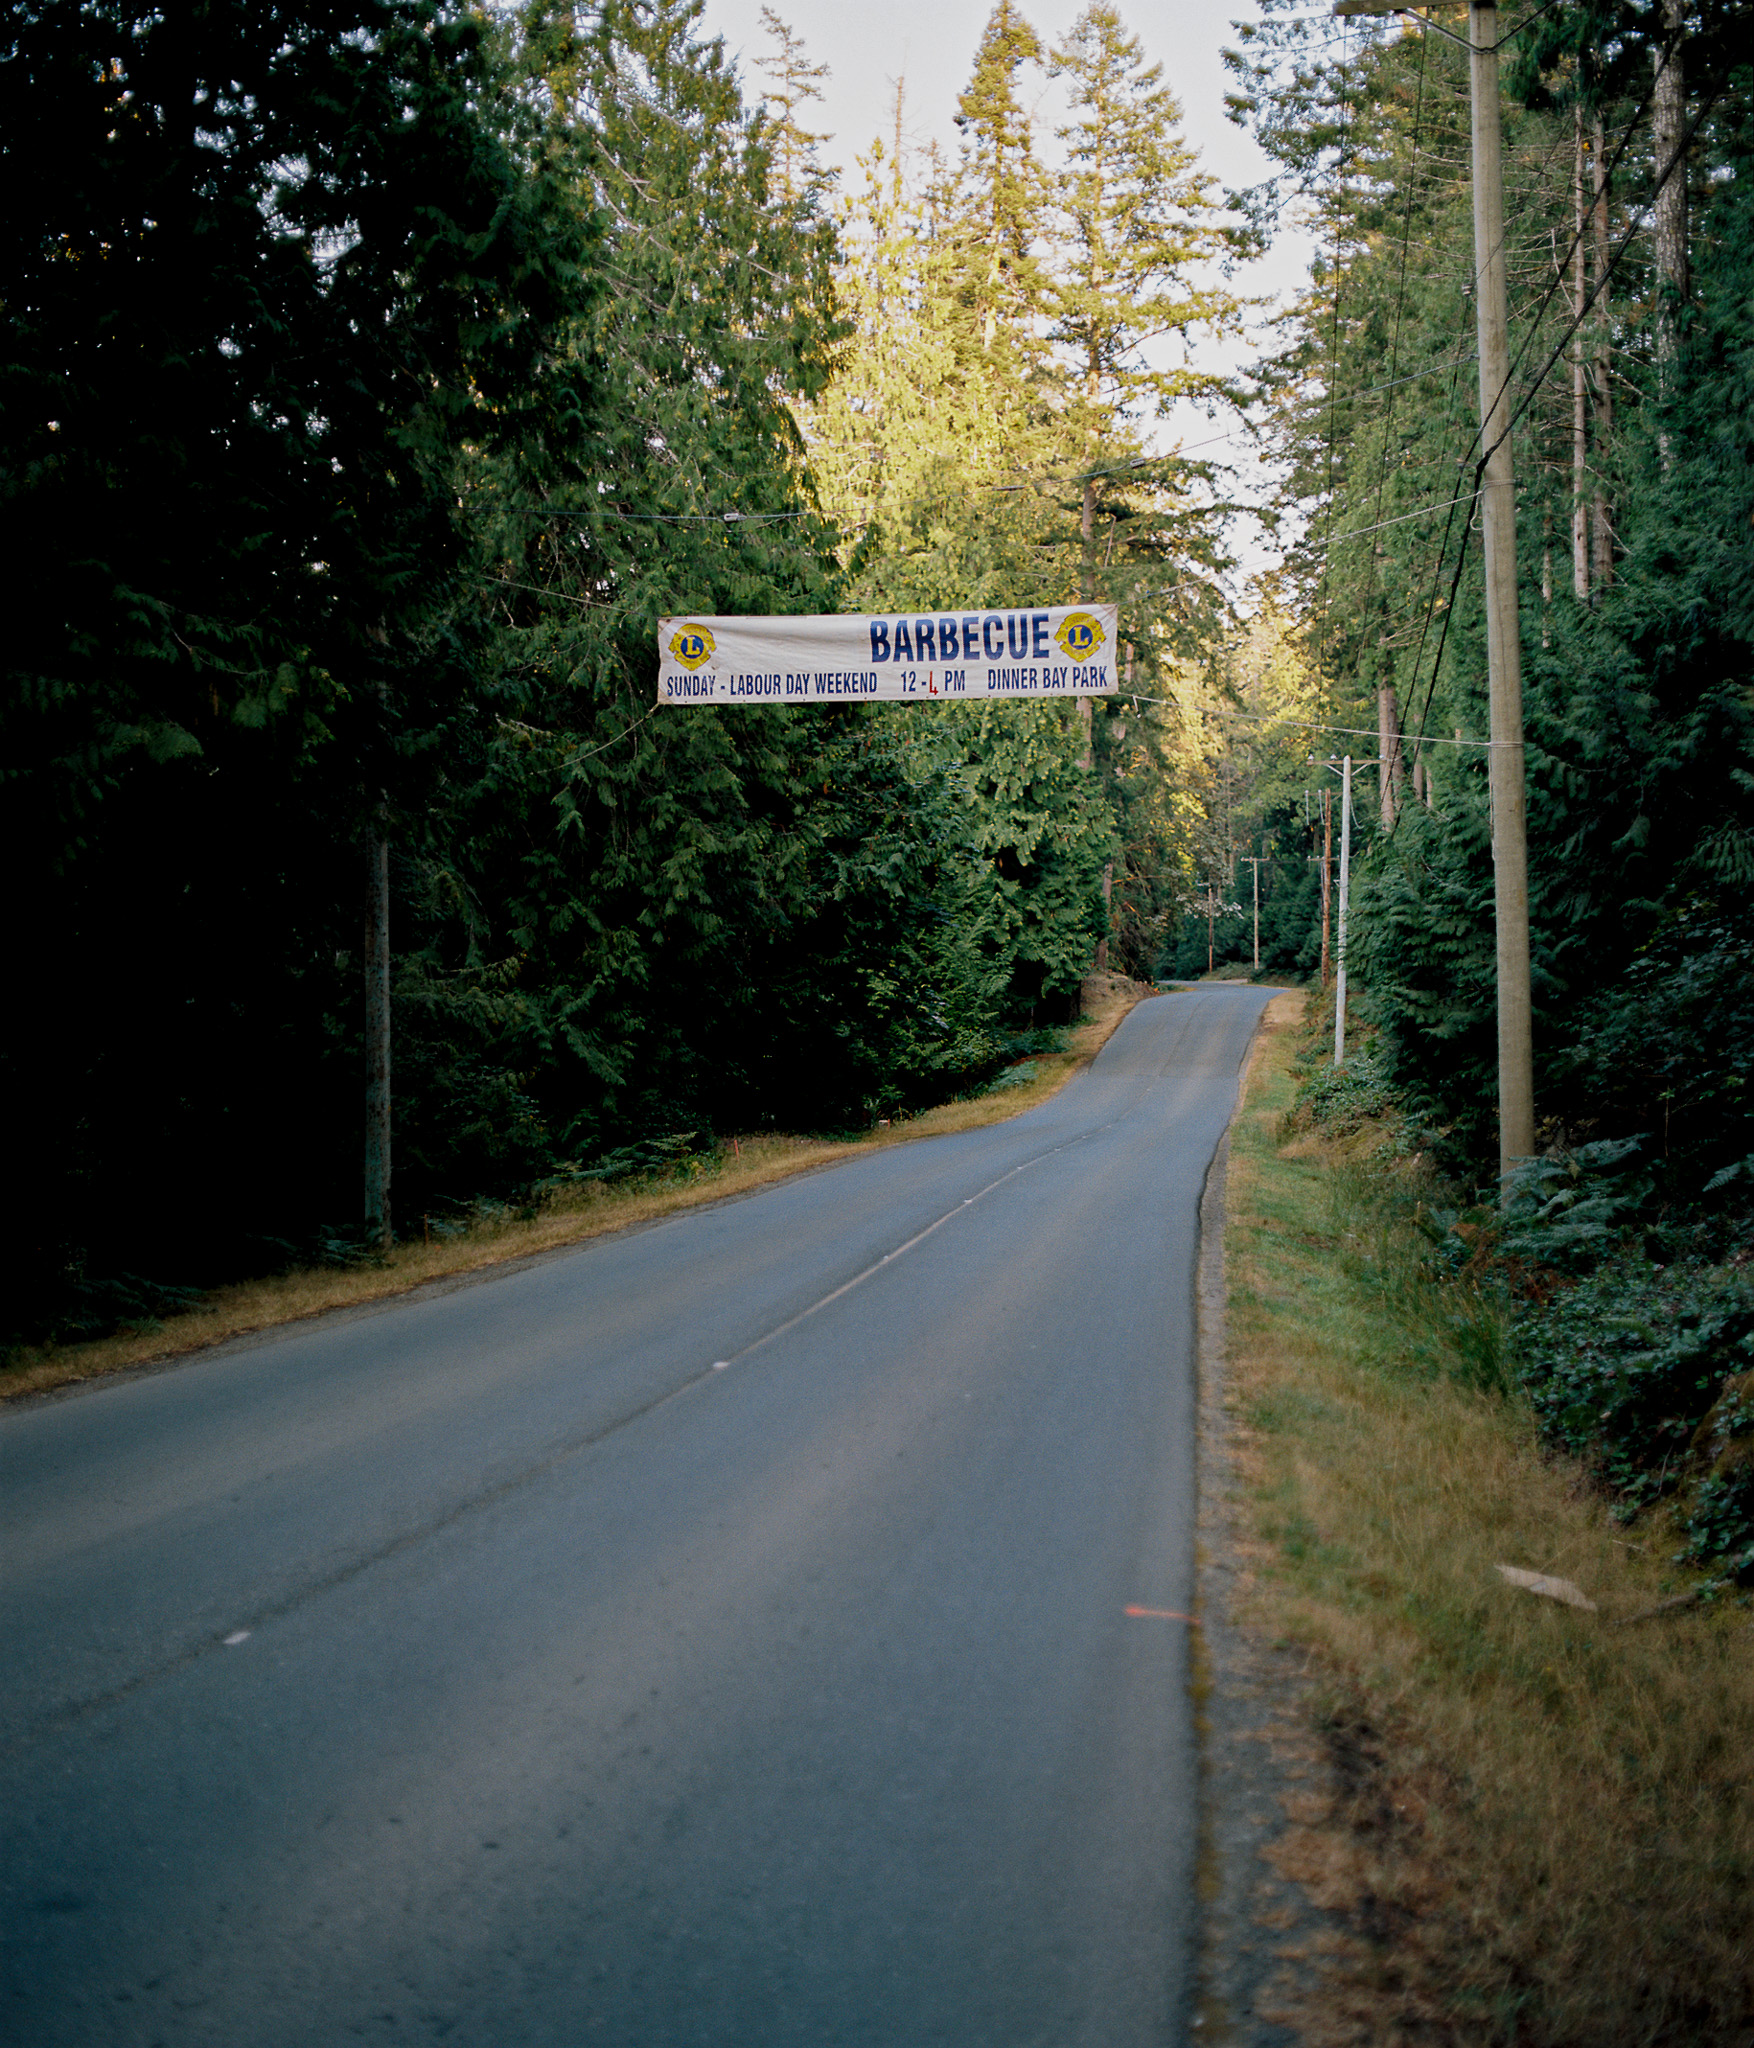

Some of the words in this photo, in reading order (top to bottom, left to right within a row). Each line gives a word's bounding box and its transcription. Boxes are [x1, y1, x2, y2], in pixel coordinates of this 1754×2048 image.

[870, 613, 1049, 663] BARBECUE
[667, 675, 716, 697] SUNDAY
[730, 674, 781, 696] LABOUR
[786, 673, 810, 695] DAY
[815, 672, 878, 694] WEEKEND
[945, 670, 965, 691] PM
[988, 668, 1037, 690] DINNER
[1042, 667, 1068, 689] BAY
[1072, 666, 1108, 688] PARK
